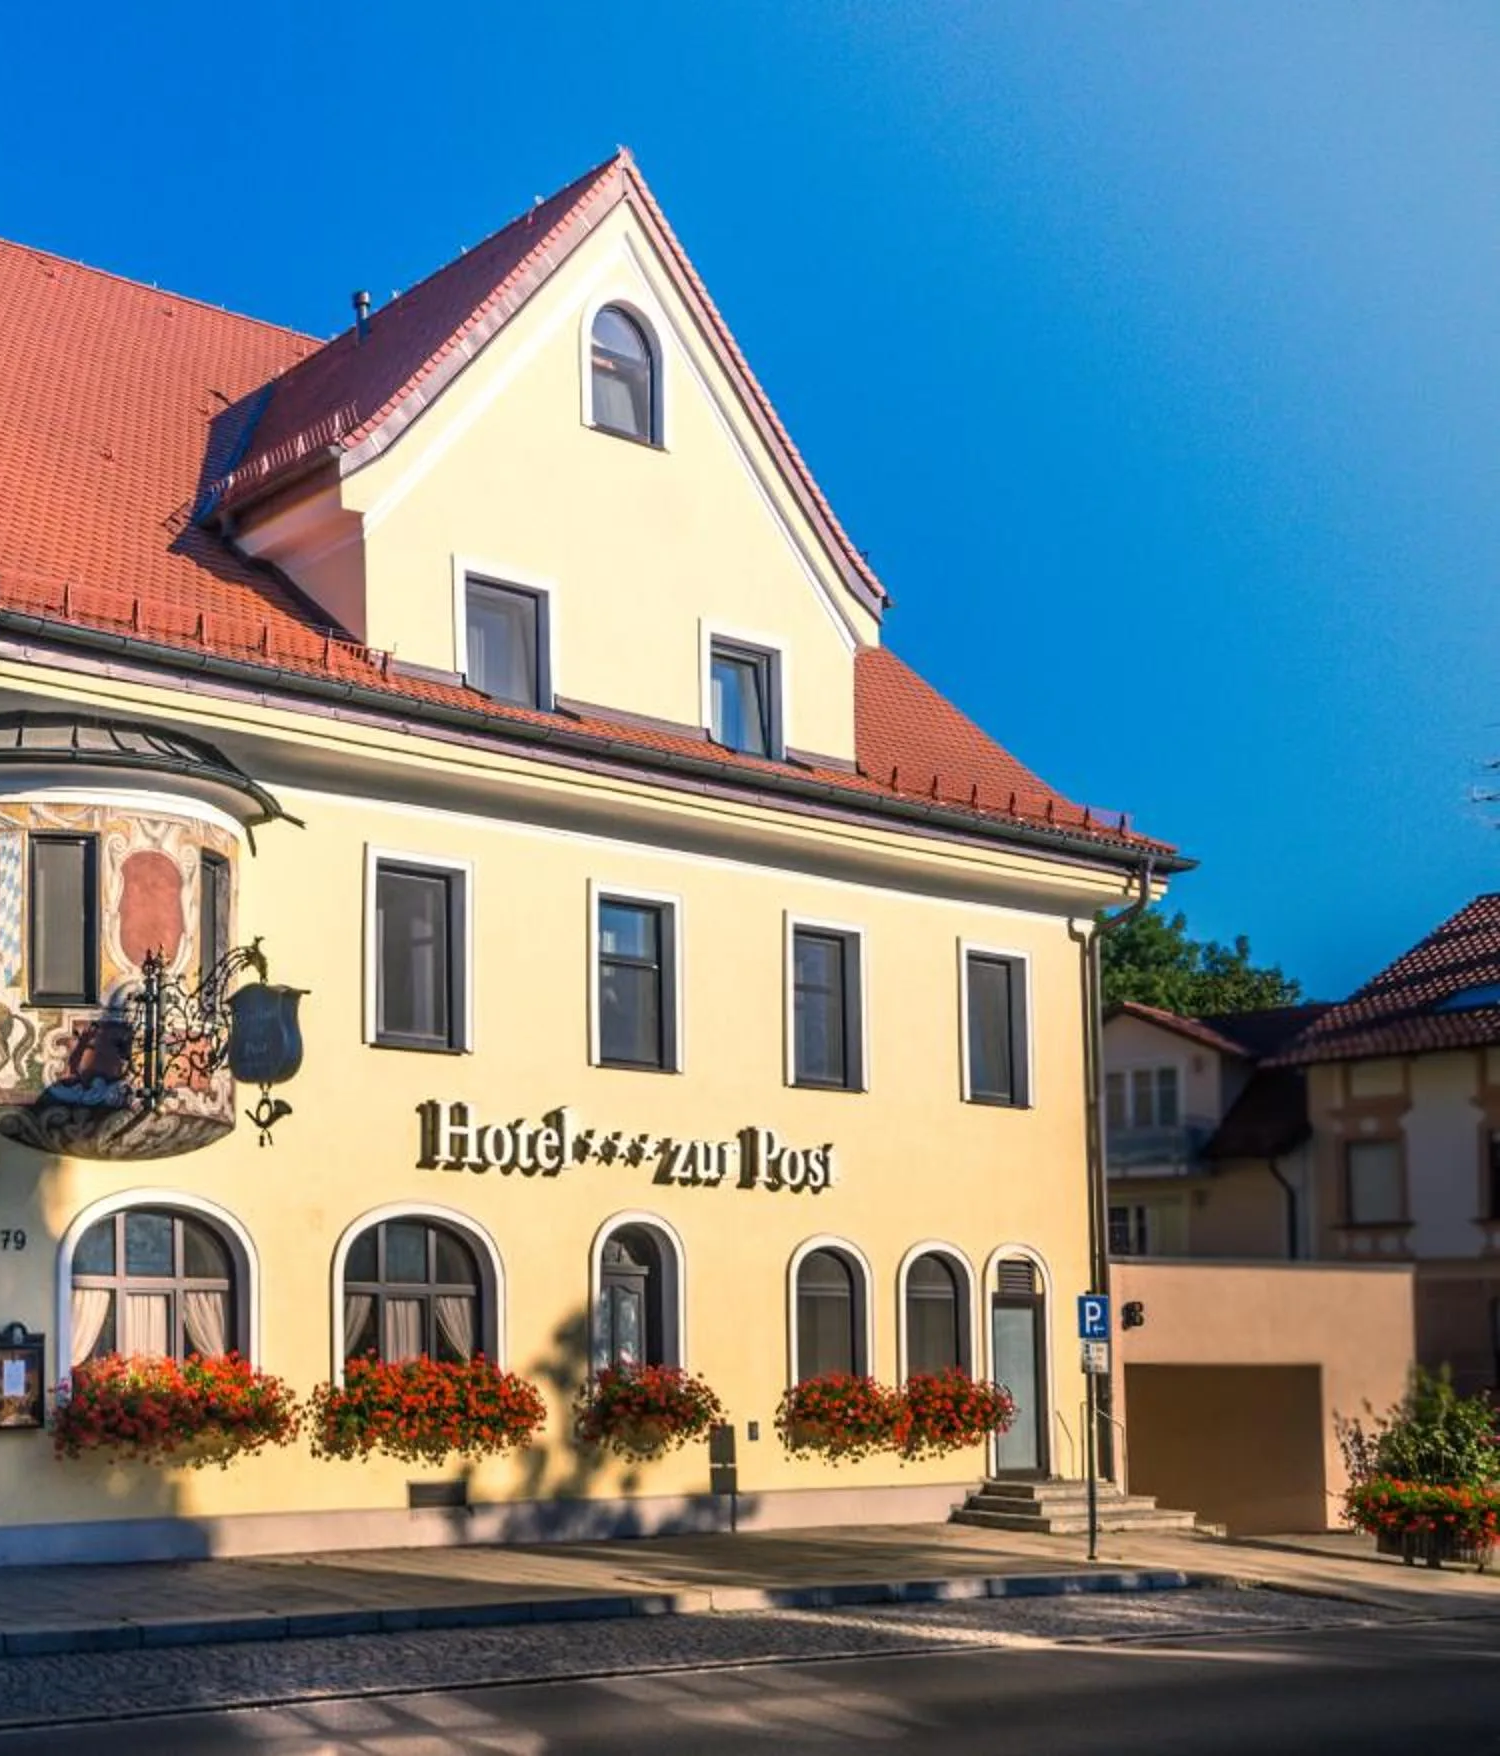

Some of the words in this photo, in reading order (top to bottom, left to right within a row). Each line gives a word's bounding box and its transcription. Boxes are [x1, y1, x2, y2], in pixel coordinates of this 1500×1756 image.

[415, 1099, 578, 1177] Hotel
[652, 1138, 740, 1187] zur
[736, 1126, 837, 1194] Post
[0, 1229, 27, 1250] 79
[1085, 1301, 1101, 1334] P
